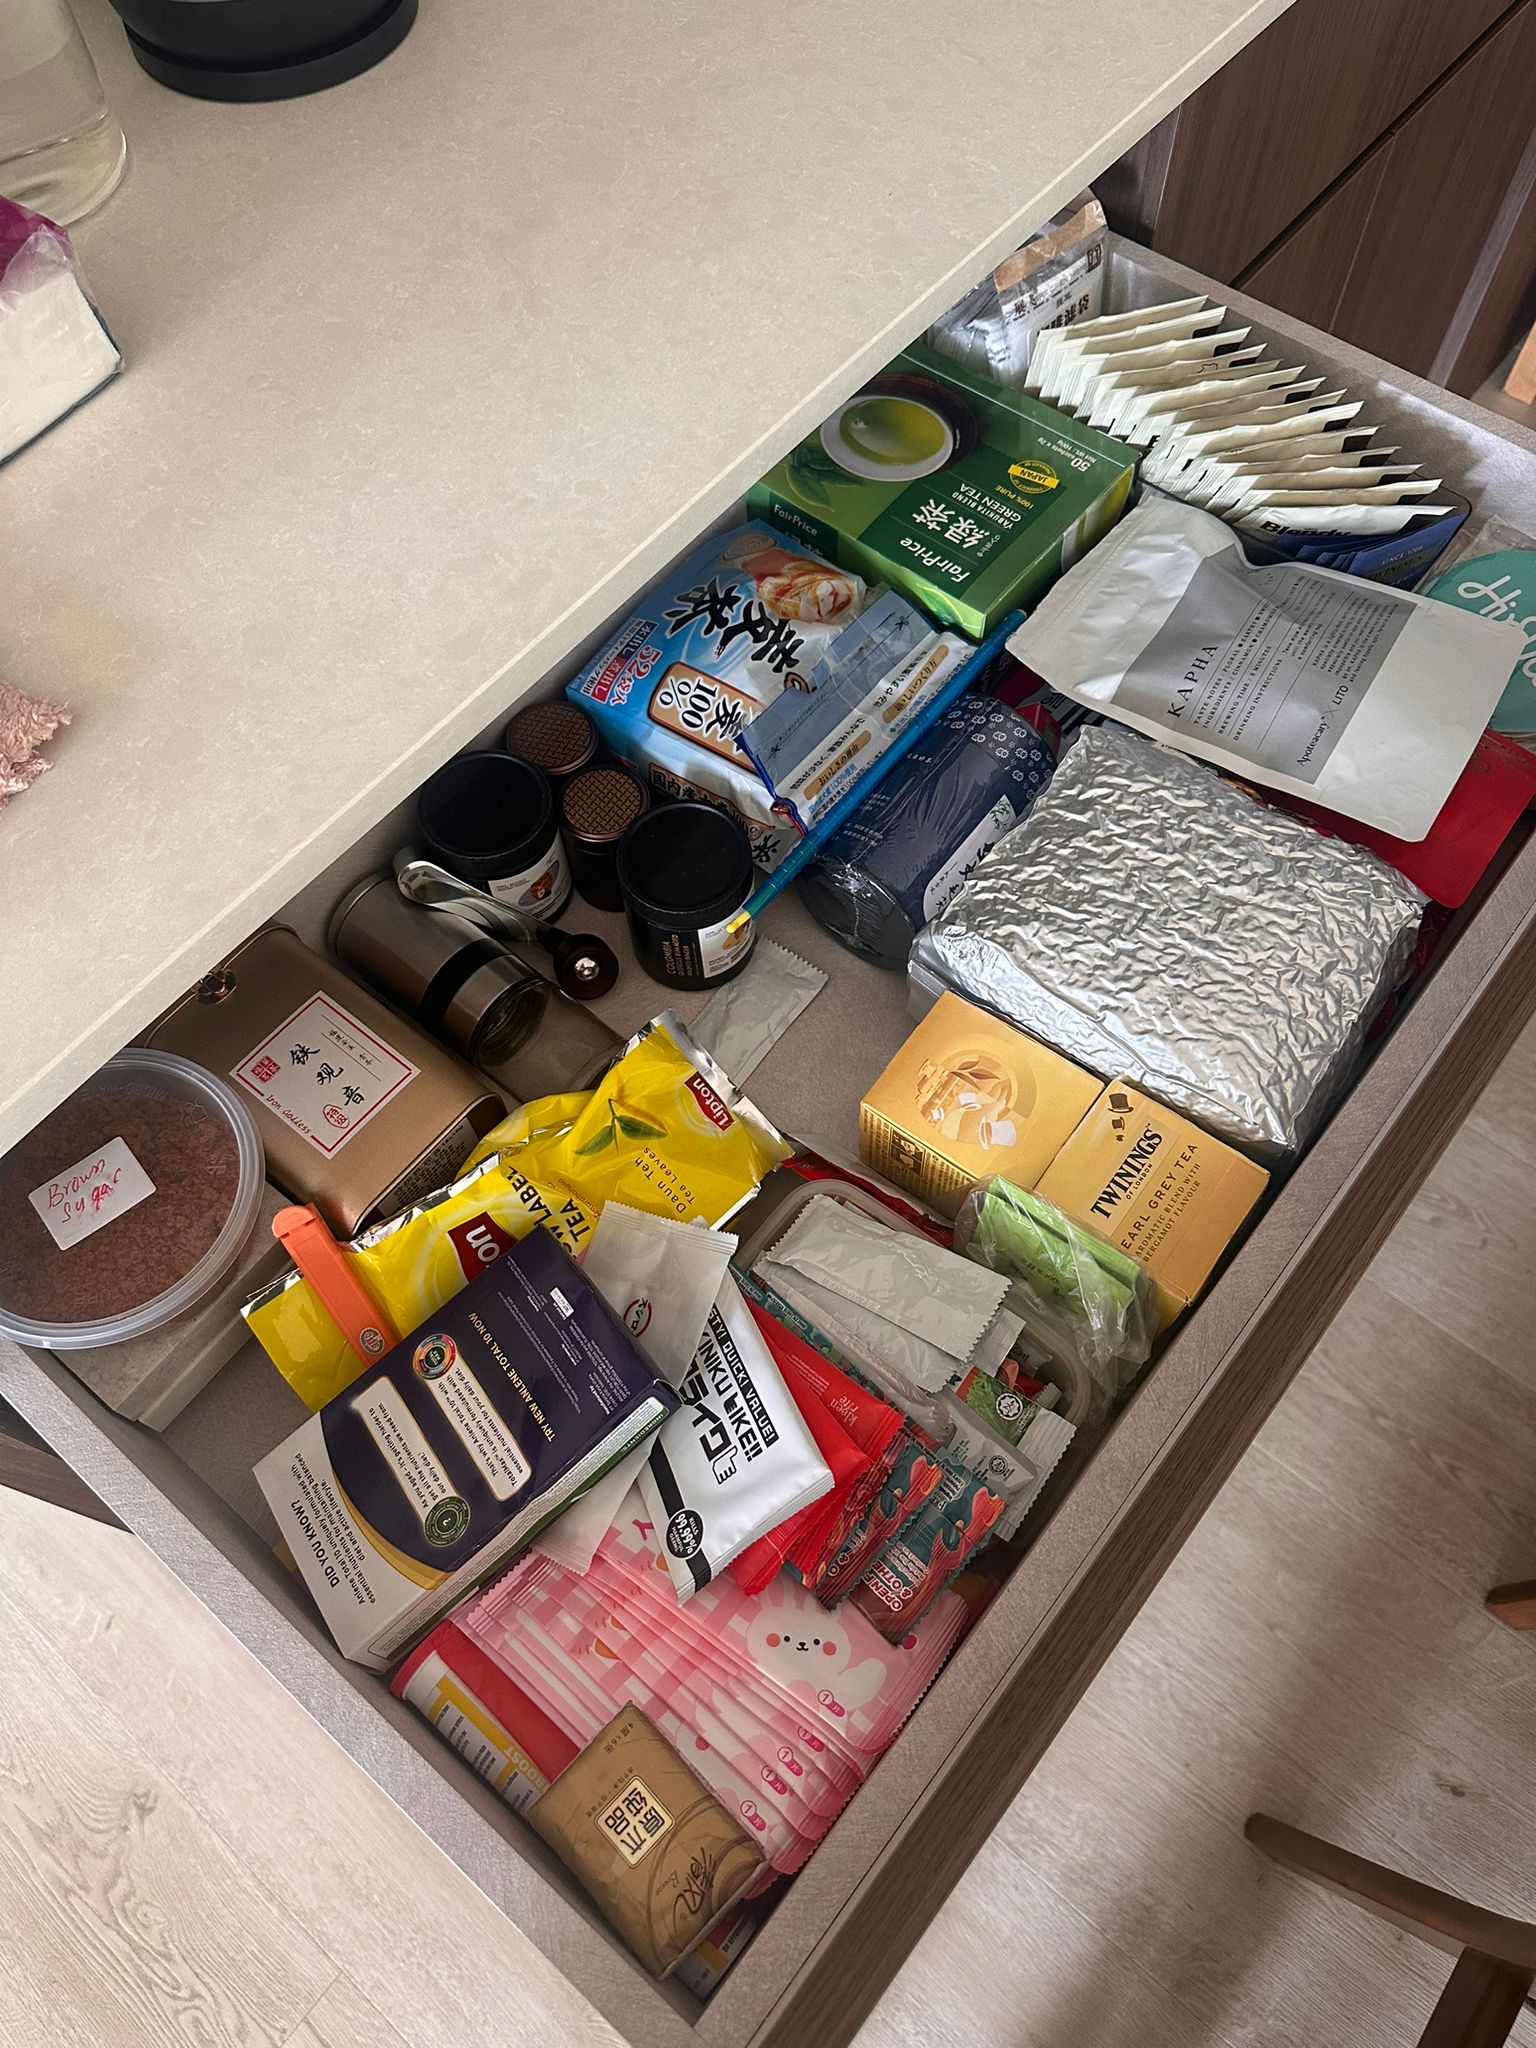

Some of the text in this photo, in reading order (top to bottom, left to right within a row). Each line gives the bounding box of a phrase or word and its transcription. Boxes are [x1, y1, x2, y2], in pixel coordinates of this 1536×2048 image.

[1018, 467, 1048, 485] JAPAN
[1071, 455, 1091, 473] 50
[770, 503, 819, 536] FairPrice
[951, 489, 1014, 530] YABUKITA BLEND
[957, 482, 1022, 522] GREEN TEA
[994, 483, 1034, 510] 100% PURE
[909, 492, 991, 555] 緑茶
[897, 533, 969, 585] FairPrice
[621, 621, 654, 660] 水出し
[605, 640, 662, 710] 52袋入
[1166, 638, 1219, 720] KAPHA
[1192, 647, 1240, 725] TASTE NOTES FLORAL
[1202, 643, 1254, 728] INGREDIENTS CINNAMON
[1217, 644, 1272, 734] BREWING TIME MINUTES
[1232, 657, 1282, 741] DRINKING INSTRUCTIONS
[1332, 683, 1349, 706] LITO
[289, 1043, 367, 1107] 铁观音
[689, 1075, 731, 1127] Lipton
[266, 1093, 312, 1136] Iron Goddess
[47, 1158, 105, 1209] Brown
[502, 1164, 552, 1226] LABEL
[632, 1155, 687, 1213] Daun Teh
[640, 1145, 696, 1204] Tea Leaves
[1089, 1126, 1164, 1223] TWININGS
[1120, 1140, 1199, 1250] EARL GREY TEA
[1125, 1163, 1154, 1200] OF LONDON
[553, 1196, 594, 1242] TEA
[1134, 1162, 1202, 1258] AROMATIC BLEND WITH
[1142, 1179, 1202, 1263] BERGAMOT FLAVOUR
[445, 1373, 457, 1388] with
[467, 1310, 558, 1441] TRY NEW ANLENE TOTAL 10 NOW
[720, 1341, 776, 1441] QUICK! VALUE!
[436, 1380, 499, 1476] That's why Anlene Total with
[453, 1386, 478, 1421] formulated
[453, 1366, 524, 1474] essential nutrients for your daily diet.
[827, 1396, 856, 1426] kleen
[367, 1406, 429, 1508] As you aged it's getting harder to
[377, 1401, 439, 1500] get all the nutrients we need from
[474, 1419, 495, 1446] uniquely
[426, 1465, 447, 1493] our daily
[289, 1463, 366, 1604] Anlene Total 10 uniquely formulated with
[289, 1498, 341, 1587] DID YOU KNOW?
[293, 1451, 377, 1604] essential nutrients for maintaining balanced
[318, 1478, 366, 1561] diet and active lifestyle.
[669, 1532, 679, 1552] GERMS
[671, 1526, 684, 1552] HARMFUL
[673, 1512, 698, 1554] 99.99%
[688, 1516, 699, 1535] KILLS
[868, 1575, 904, 1612] OPEN
[604, 1785, 649, 1837] 纯品
[619, 1808, 666, 1856] 原木
